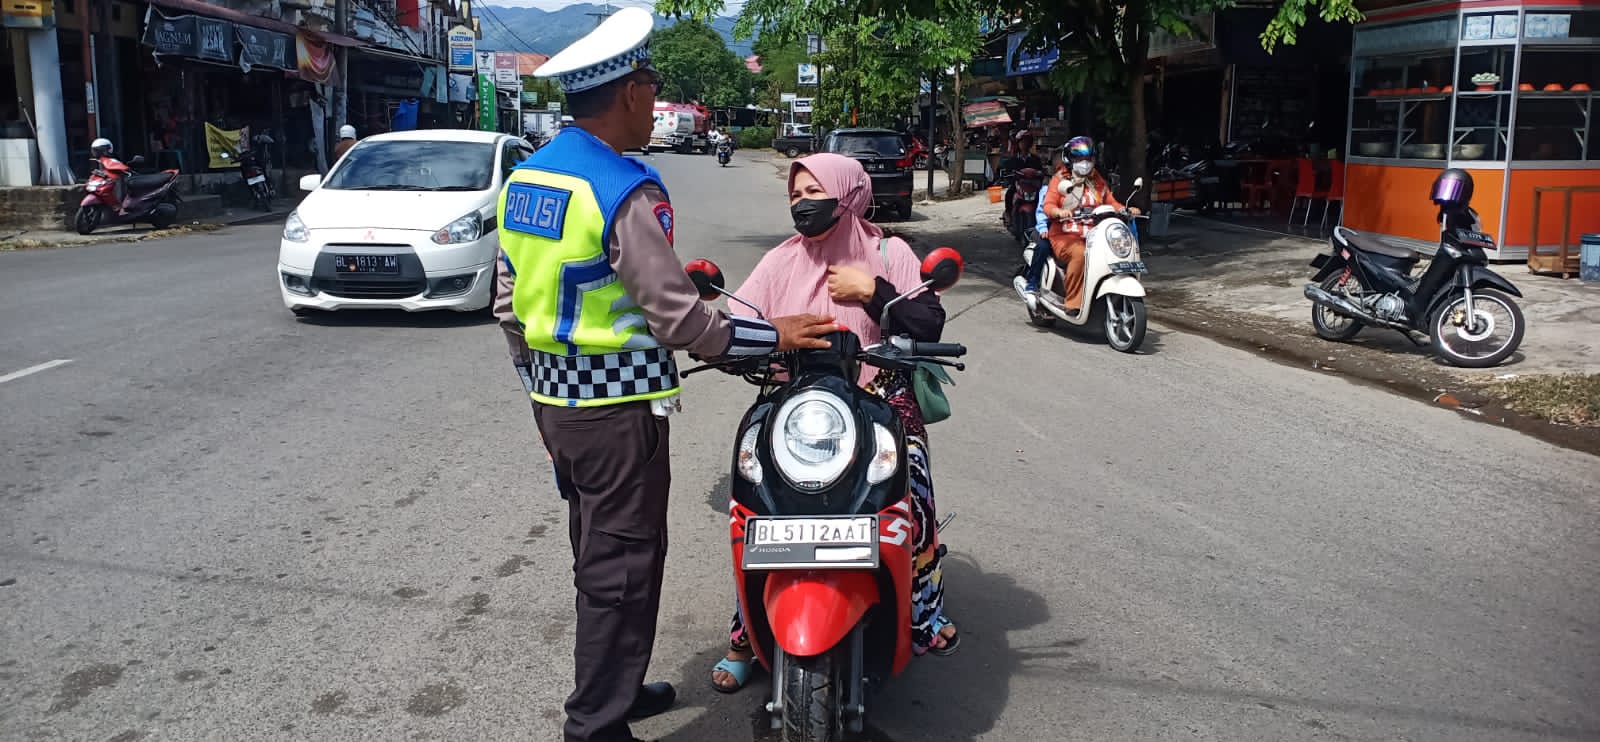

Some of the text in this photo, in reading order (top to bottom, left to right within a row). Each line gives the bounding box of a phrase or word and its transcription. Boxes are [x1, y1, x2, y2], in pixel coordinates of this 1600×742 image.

[507, 191, 562, 231] POLISI
[336, 255, 347, 267] BL
[356, 255, 377, 267] 1813
